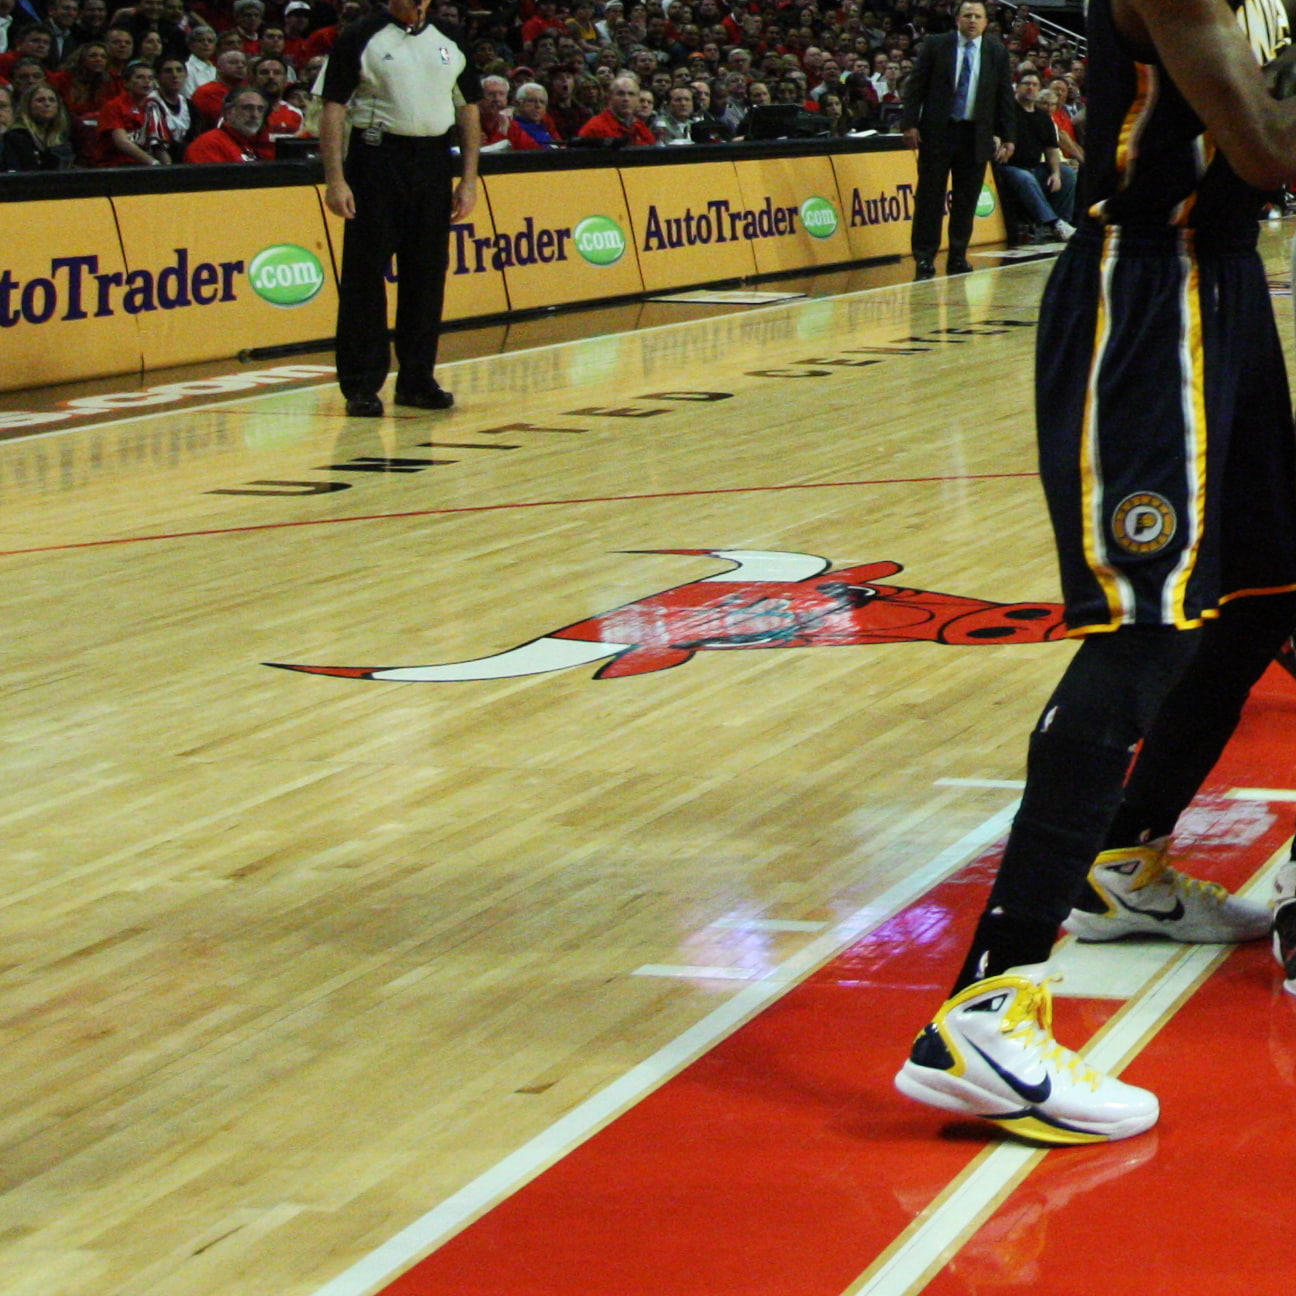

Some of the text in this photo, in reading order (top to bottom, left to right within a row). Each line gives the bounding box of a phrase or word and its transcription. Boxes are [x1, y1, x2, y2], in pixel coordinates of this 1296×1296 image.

[578, 229, 622, 252] .com
[643, 195, 798, 252] AutoTrader
[254, 256, 320, 290] .com
[203, 320, 1039, 497] UNITED CENTER
